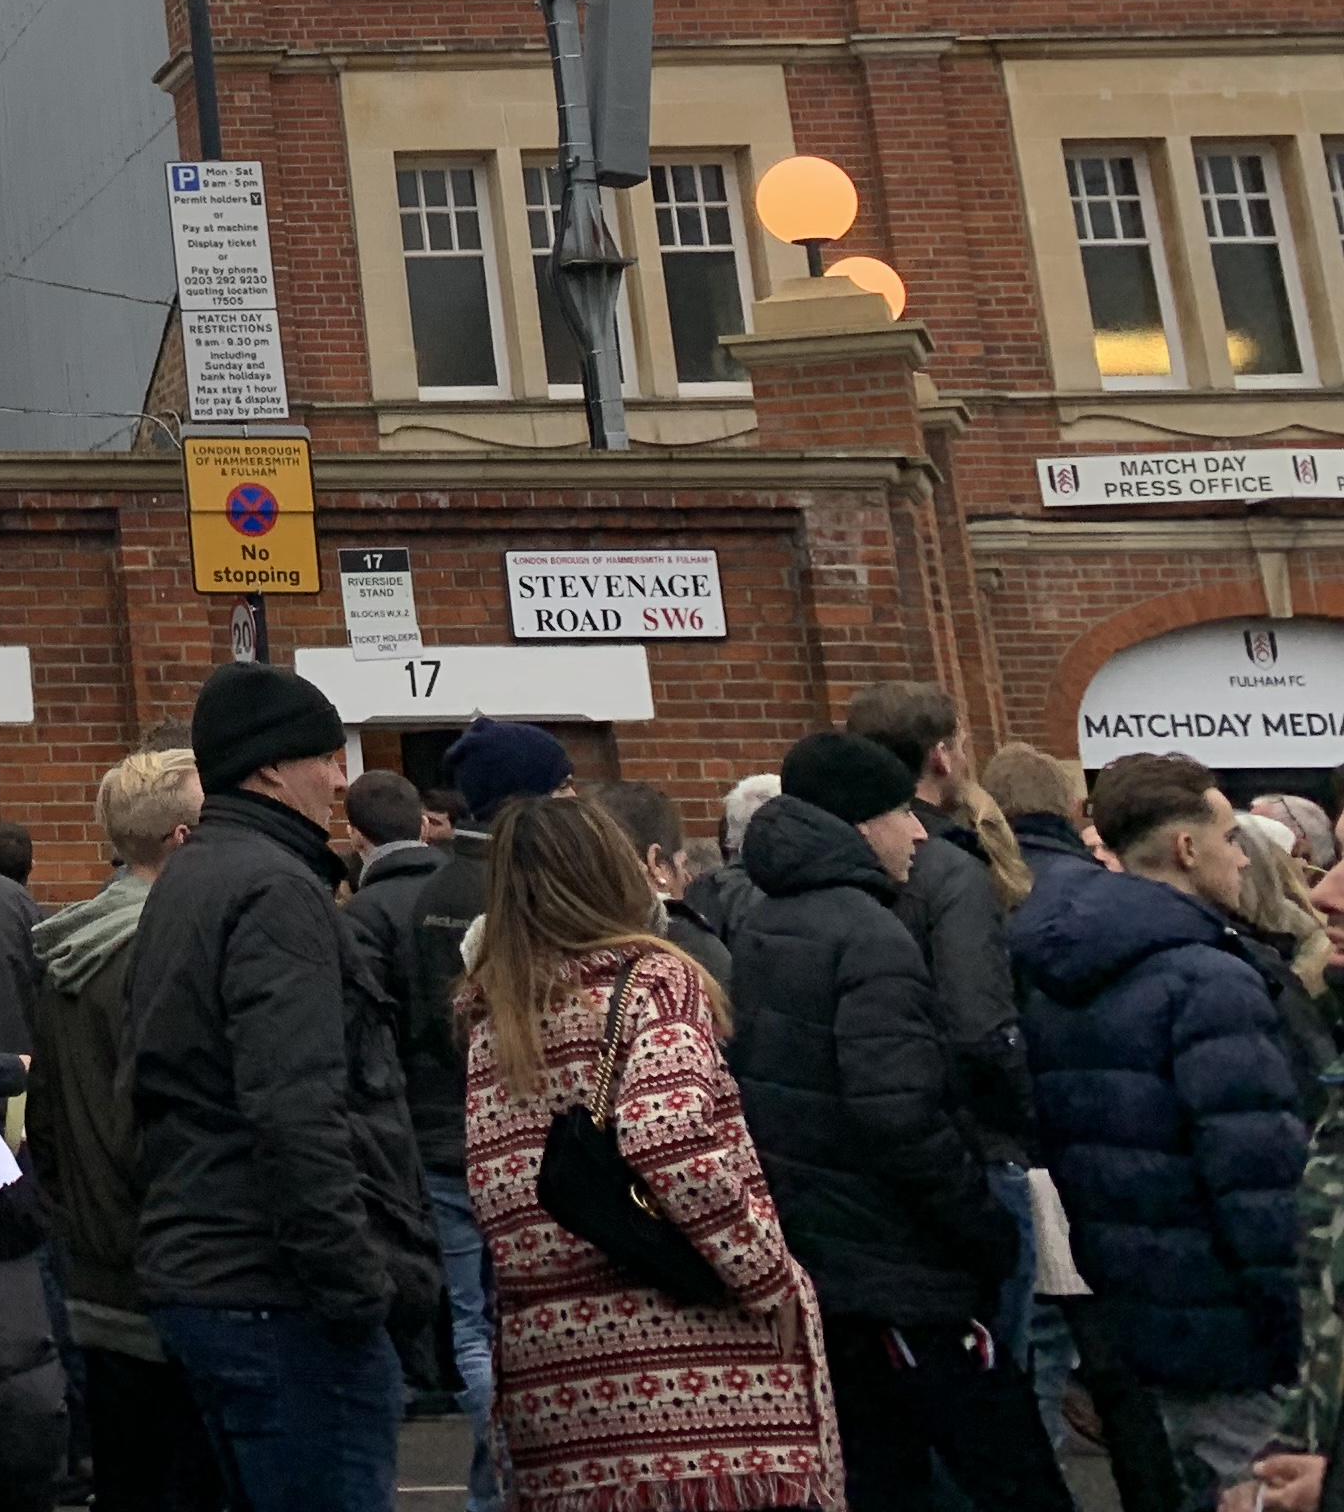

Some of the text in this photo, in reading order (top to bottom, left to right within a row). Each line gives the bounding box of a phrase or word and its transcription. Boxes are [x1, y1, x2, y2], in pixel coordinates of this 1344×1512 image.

[206, 167, 253, 176] Mon Sat
[203, 179, 209, 187] 9
[234, 179, 241, 187] 5
[243, 180, 258, 188] pm
[174, 196, 207, 204] Permit
[210, 195, 247, 204] holders
[182, 223, 259, 233] Pay at machine
[187, 239, 256, 249] Display ticket
[191, 266, 258, 276] Pay by phone
[184, 276, 213, 285] 0203
[186, 286, 268, 296] quoting location
[197, 313, 262, 323] MATCH DAY
[189, 324, 273, 334] RESTRICTIONS
[195, 338, 202, 346] 9
[253, 338, 269, 347] pm
[205, 361, 265, 371] Sunday and
[200, 372, 271, 381] bank holidays
[197, 386, 218, 394] Max
[222, 386, 243, 395] stay
[254, 385, 277, 393] hour
[195, 395, 281, 406] for pay & display
[194, 406, 284, 417] and pay by phone
[193, 446, 301, 455] LONDON BOROUGH
[196, 457, 300, 466] OF HAMMERSMITH
[1120, 456, 1246, 476] MATCH DAY
[220, 468, 277, 476] & FULHAM
[1104, 476, 1273, 497] PRESS OFFICE
[241, 544, 269, 561] No
[363, 553, 383, 569] 17
[515, 556, 708, 565] LONDON BOROUGH OF HAMMERSMITH & FULHAM
[213, 567, 300, 586] stopping
[348, 577, 403, 586] RIVERSIDE
[518, 574, 711, 599] STEVENAGE
[359, 588, 394, 597] STAND
[534, 607, 704, 632] ROAD SW6
[233, 621, 251, 655] 20
[405, 660, 441, 697] 17
[1230, 675, 1306, 687] FULHAM FC
[1084, 713, 1252, 738] MATCHDAY
